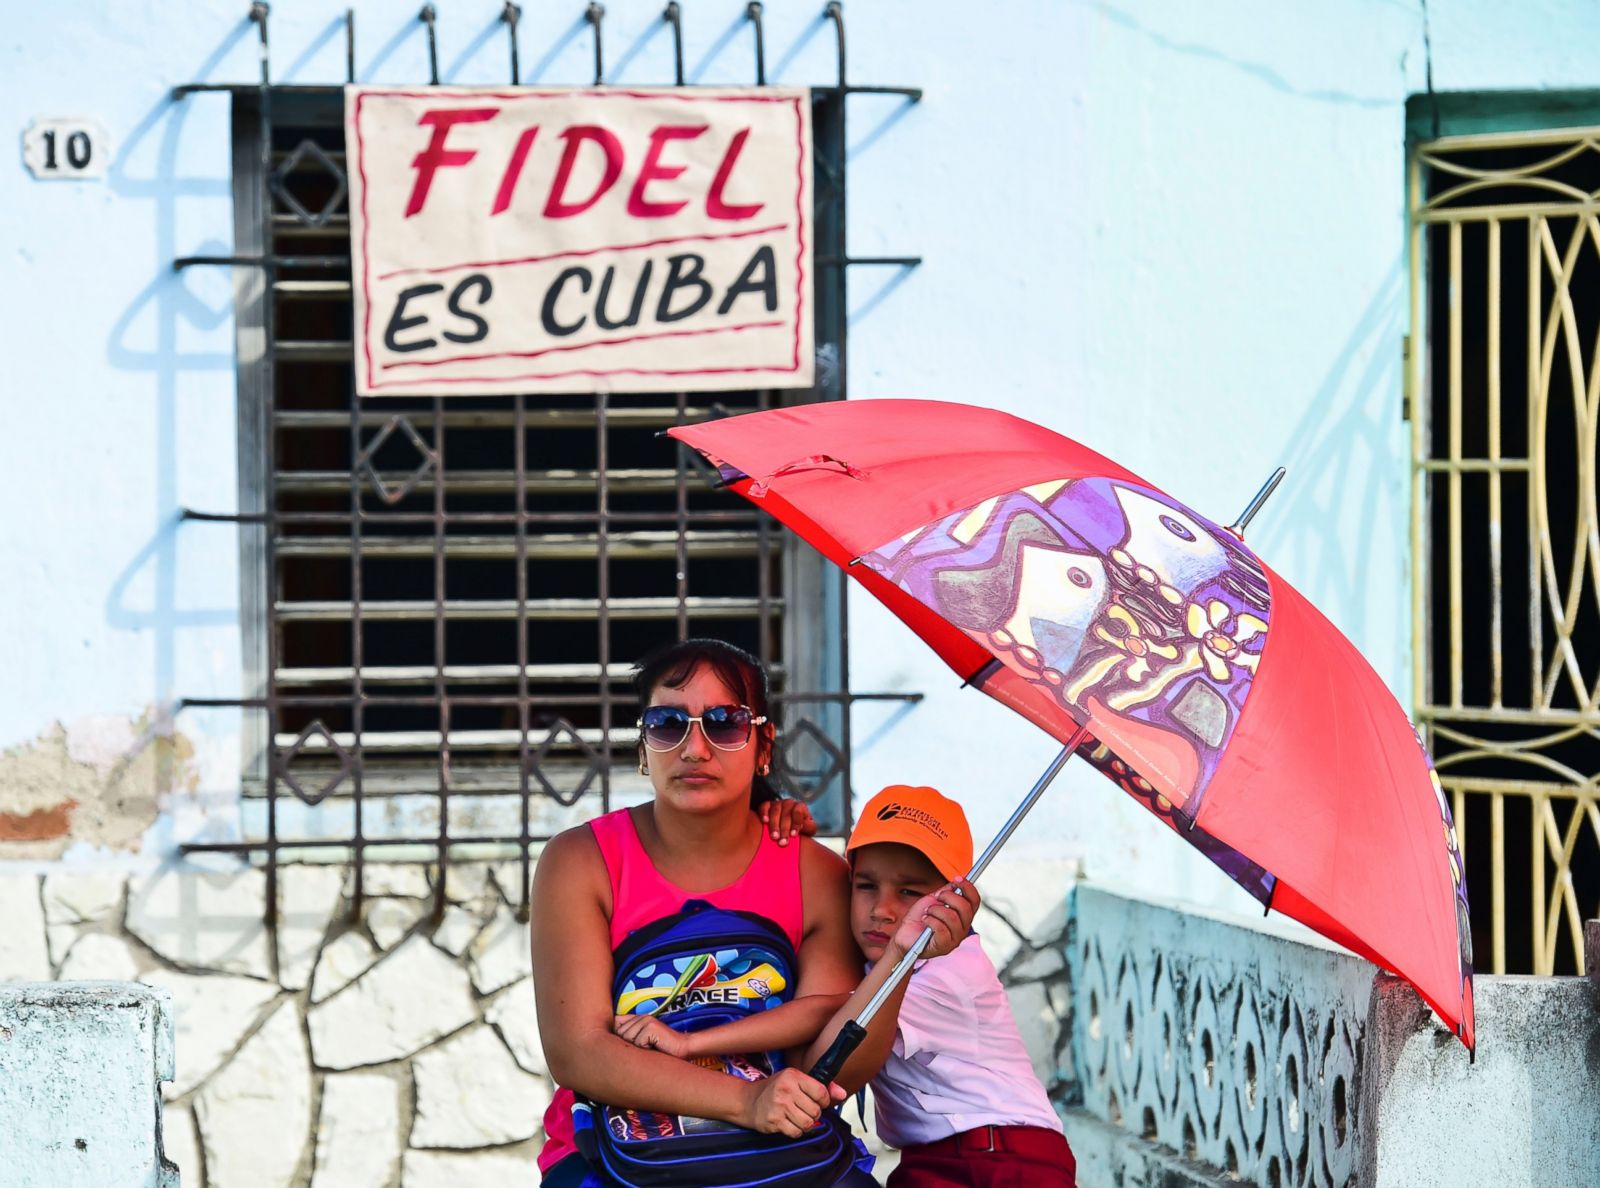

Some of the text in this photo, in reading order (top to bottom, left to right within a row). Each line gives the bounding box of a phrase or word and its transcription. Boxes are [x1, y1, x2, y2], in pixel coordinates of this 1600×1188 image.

[41, 130, 92, 170] 10
[405, 108, 765, 222] FIDEL
[384, 245, 780, 352] ES CUBA
